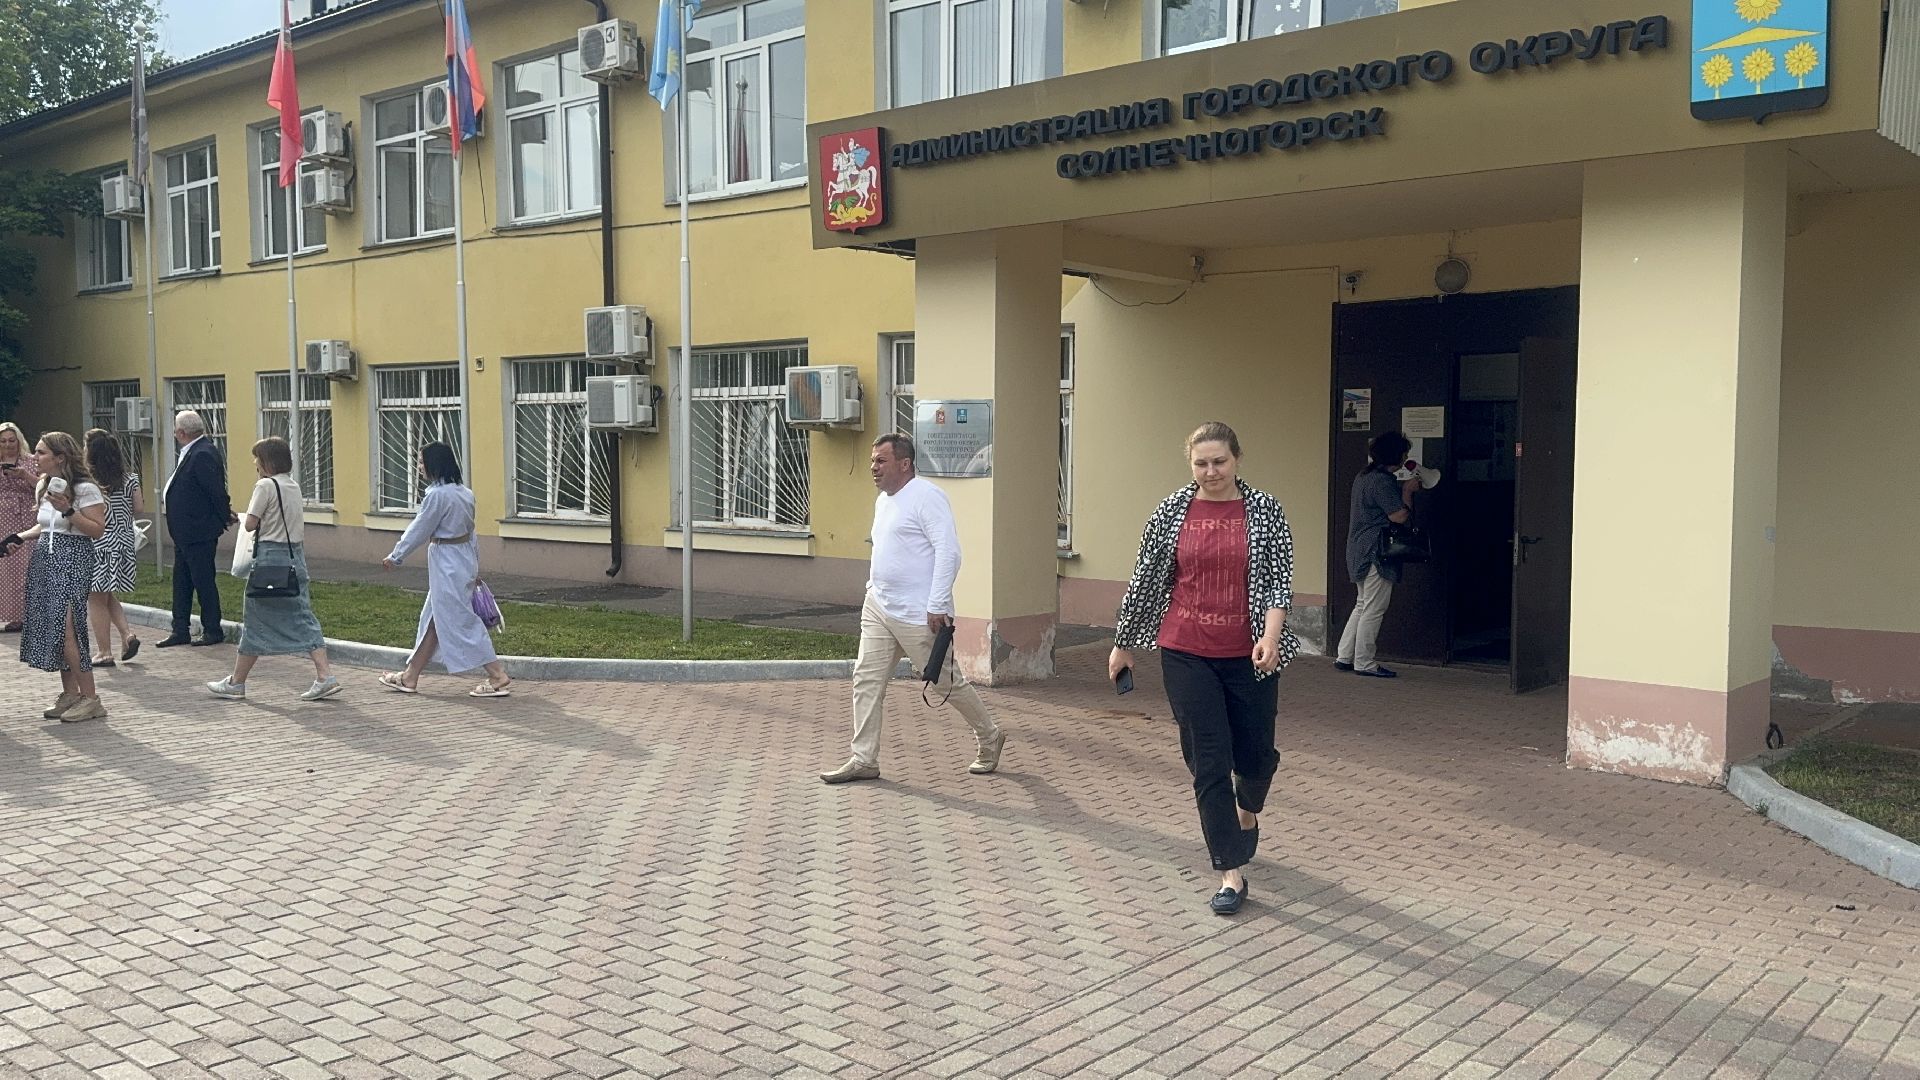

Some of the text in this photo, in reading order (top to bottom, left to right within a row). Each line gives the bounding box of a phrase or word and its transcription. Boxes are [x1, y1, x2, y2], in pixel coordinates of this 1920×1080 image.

[889, 15, 1668, 167] АДМИНИСТРАЦИЯ ГОРОДСКОГО ОКРУГА
[1056, 107, 1385, 178] СОЛНЕЧНОГОРСК
